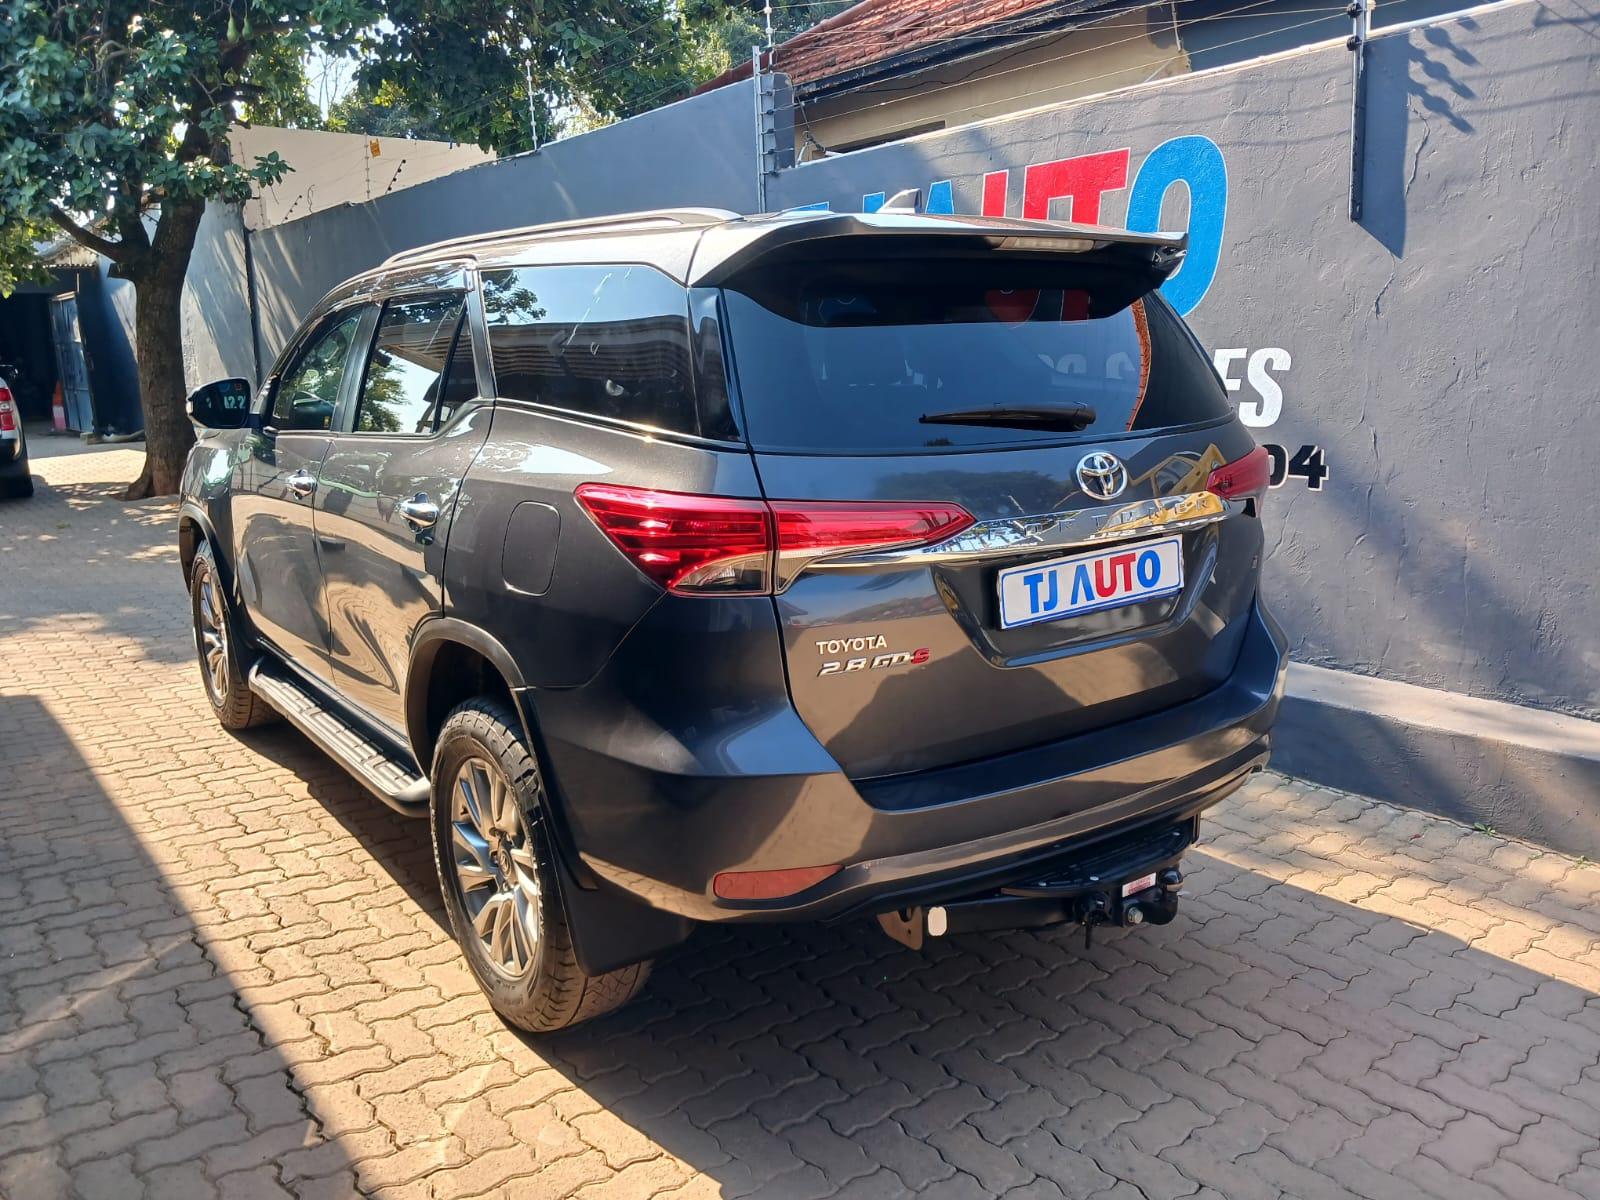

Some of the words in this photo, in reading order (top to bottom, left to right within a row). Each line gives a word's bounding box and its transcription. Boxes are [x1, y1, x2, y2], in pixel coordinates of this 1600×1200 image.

[1023, 569, 1058, 614] TJ
[1070, 550, 1161, 605] AUTO
[815, 635, 888, 655] TOYOTA
